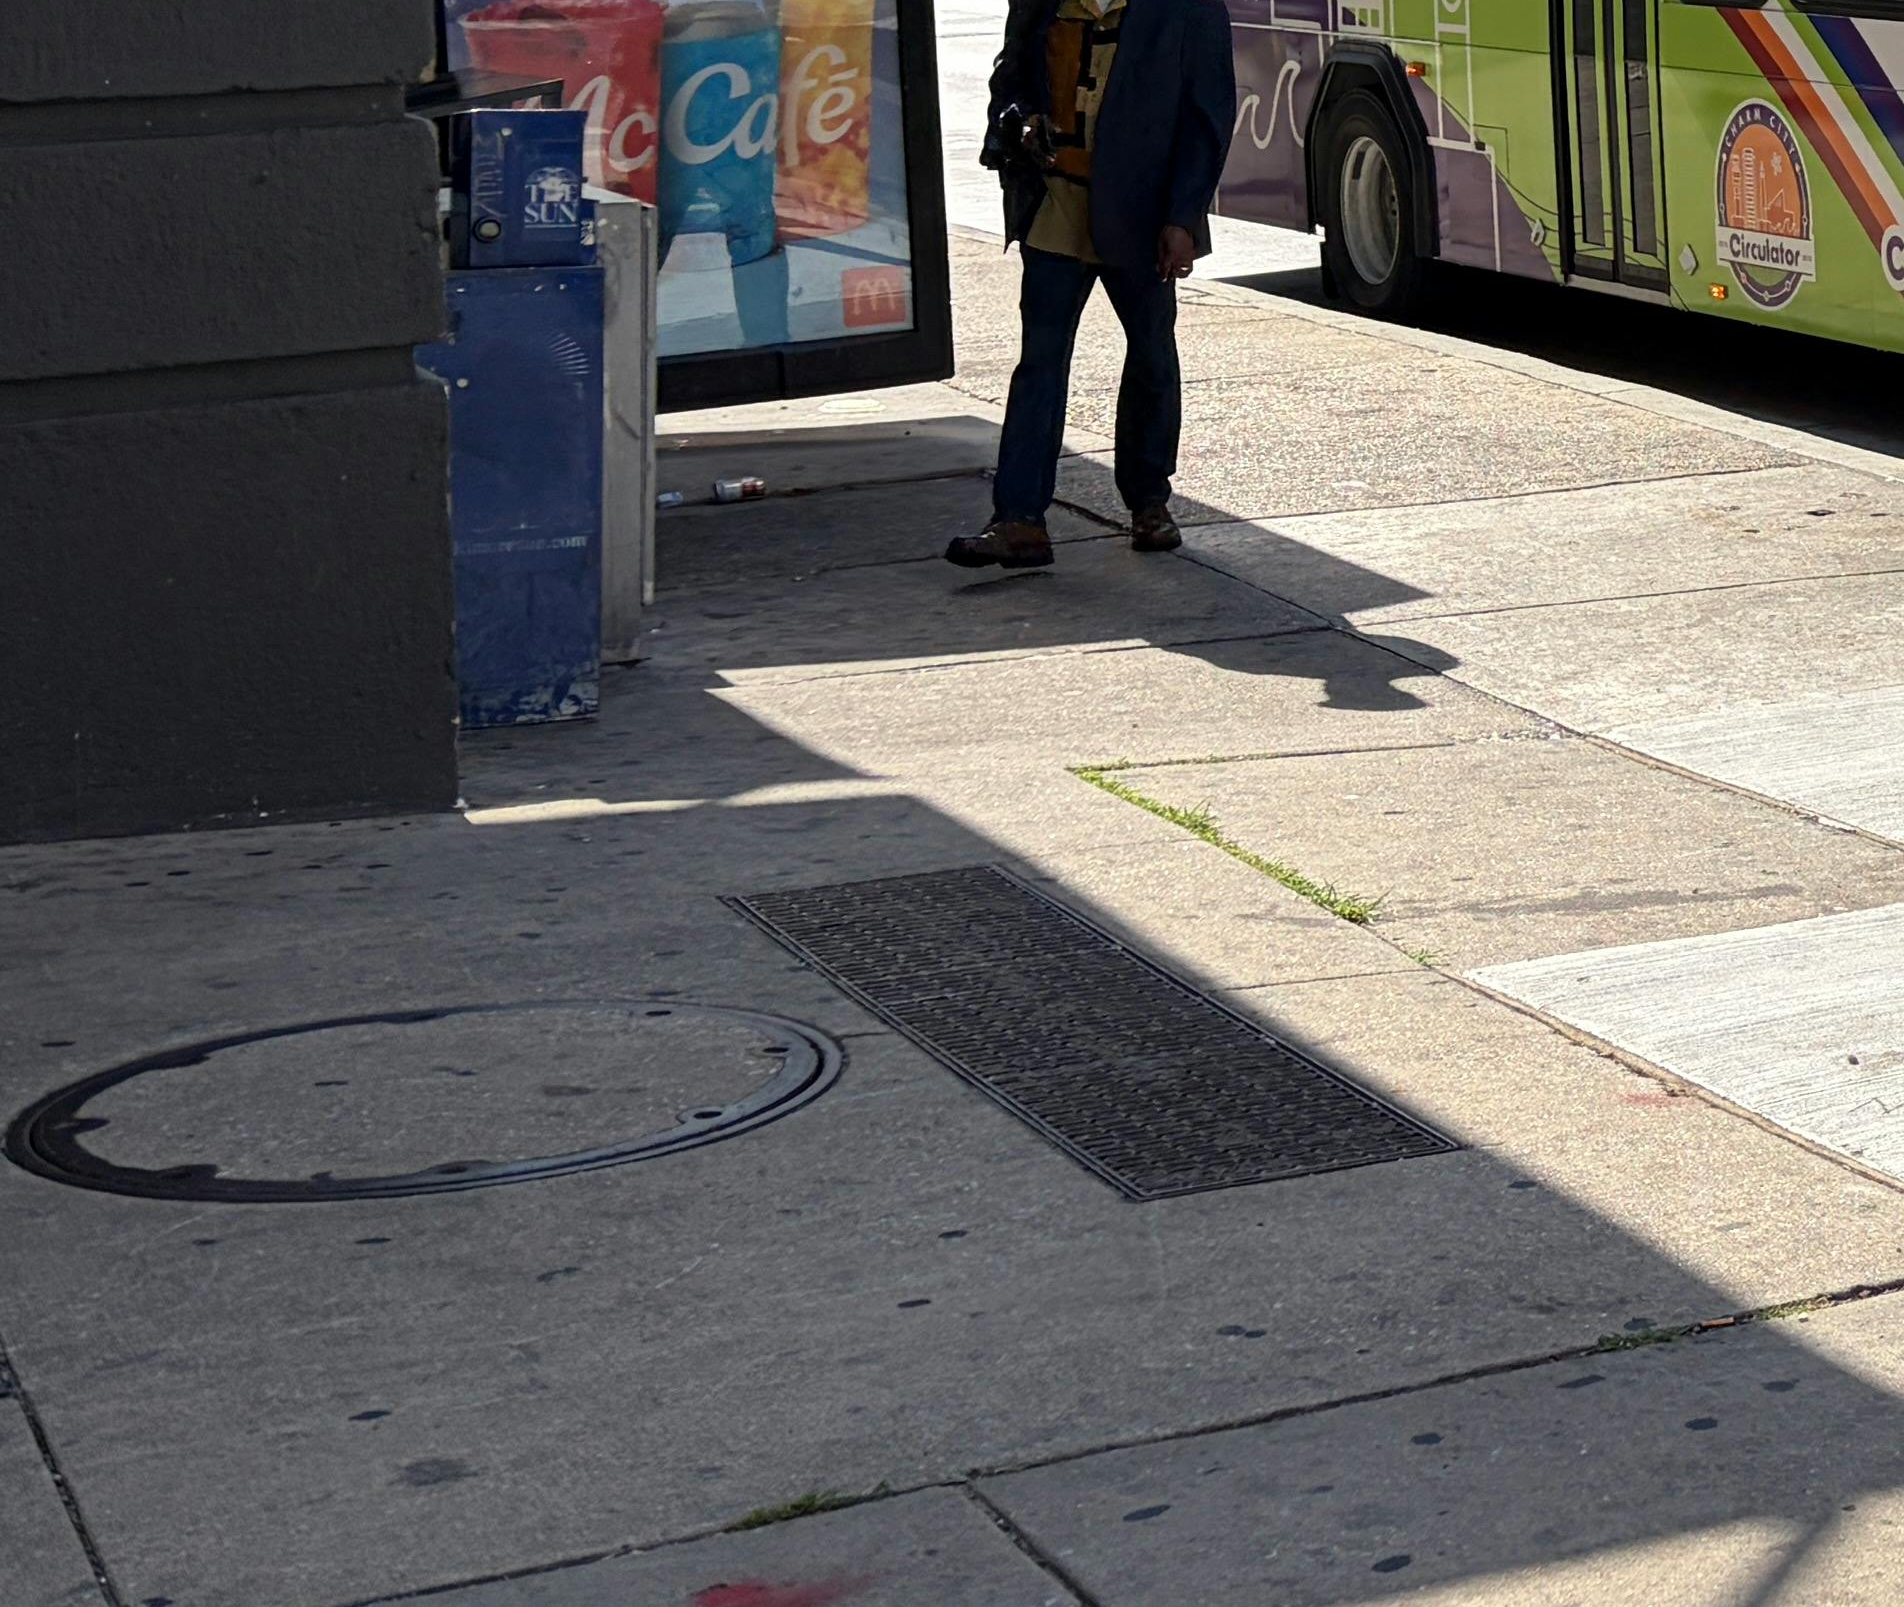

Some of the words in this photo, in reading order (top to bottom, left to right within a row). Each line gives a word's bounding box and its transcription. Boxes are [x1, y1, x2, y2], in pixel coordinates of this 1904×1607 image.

[1725, 108, 1762, 148] CHARM
[1769, 114, 1795, 156] CITY
[524, 202, 578, 223] SUN
[1729, 233, 1800, 267] Circulator
